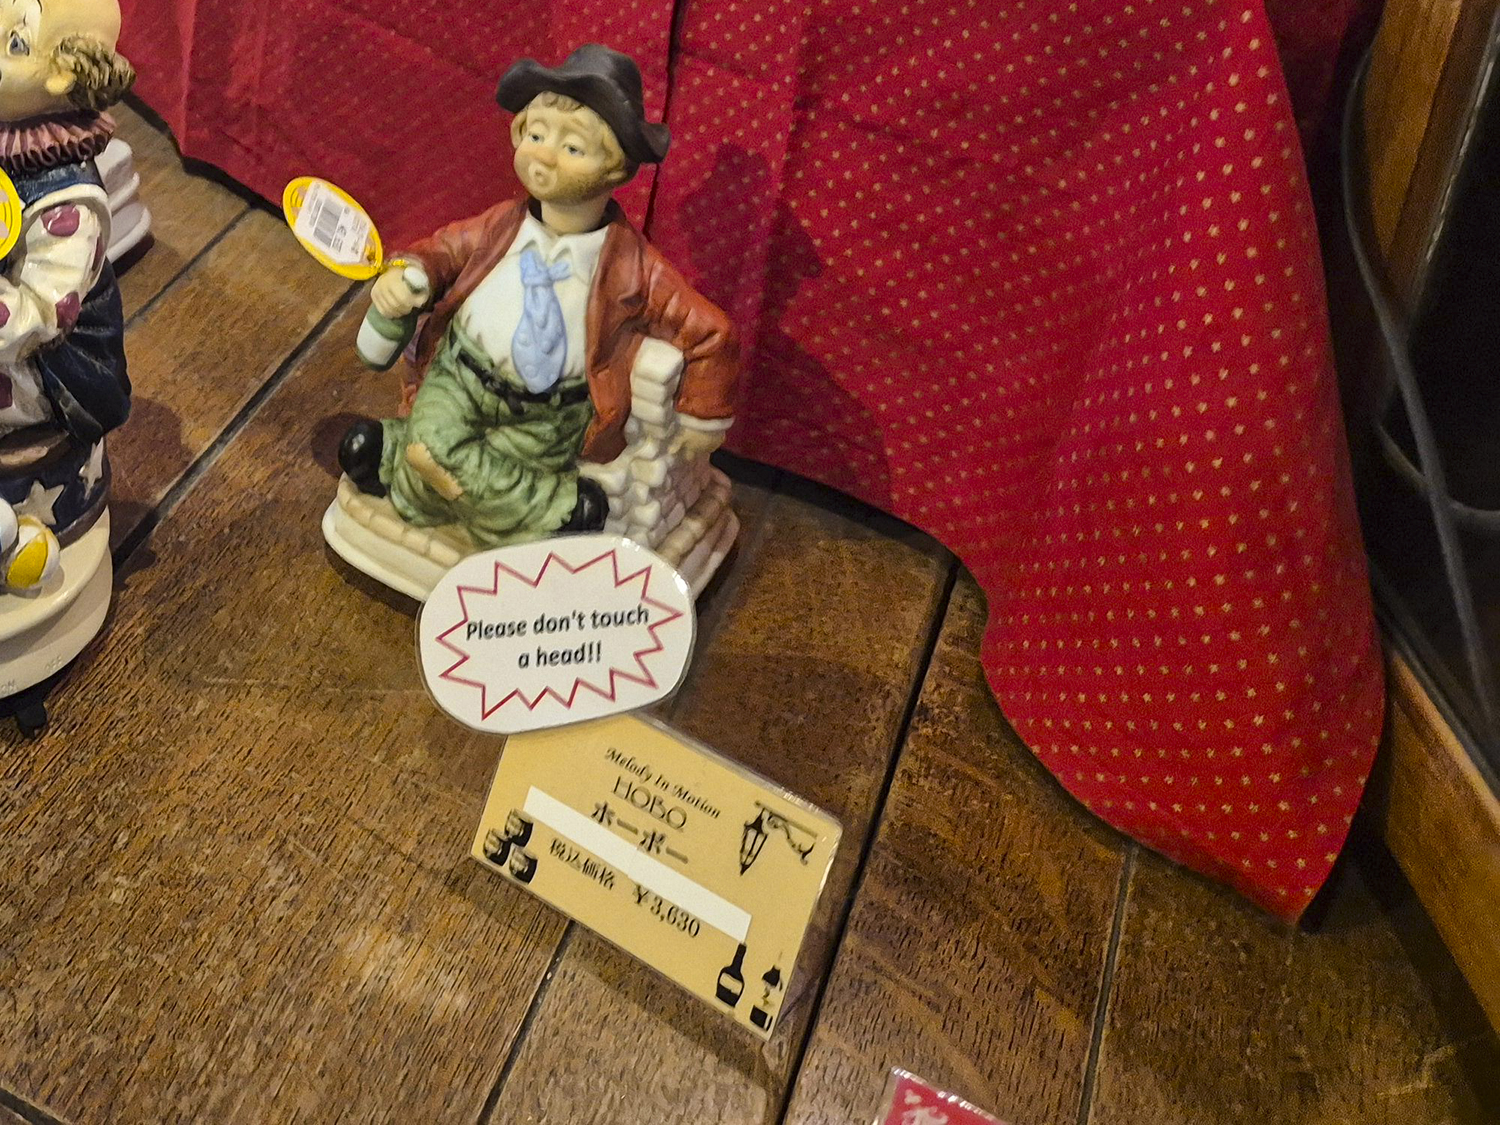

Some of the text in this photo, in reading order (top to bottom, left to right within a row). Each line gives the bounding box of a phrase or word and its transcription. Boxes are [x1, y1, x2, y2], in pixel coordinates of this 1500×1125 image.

[465, 605, 650, 641] Please don't touch
[517, 640, 602, 669] a head!!
[605, 747, 721, 820] Melody In Motion
[609, 775, 688, 832] HOBO
[548, 837, 616, 891] 税込価格
